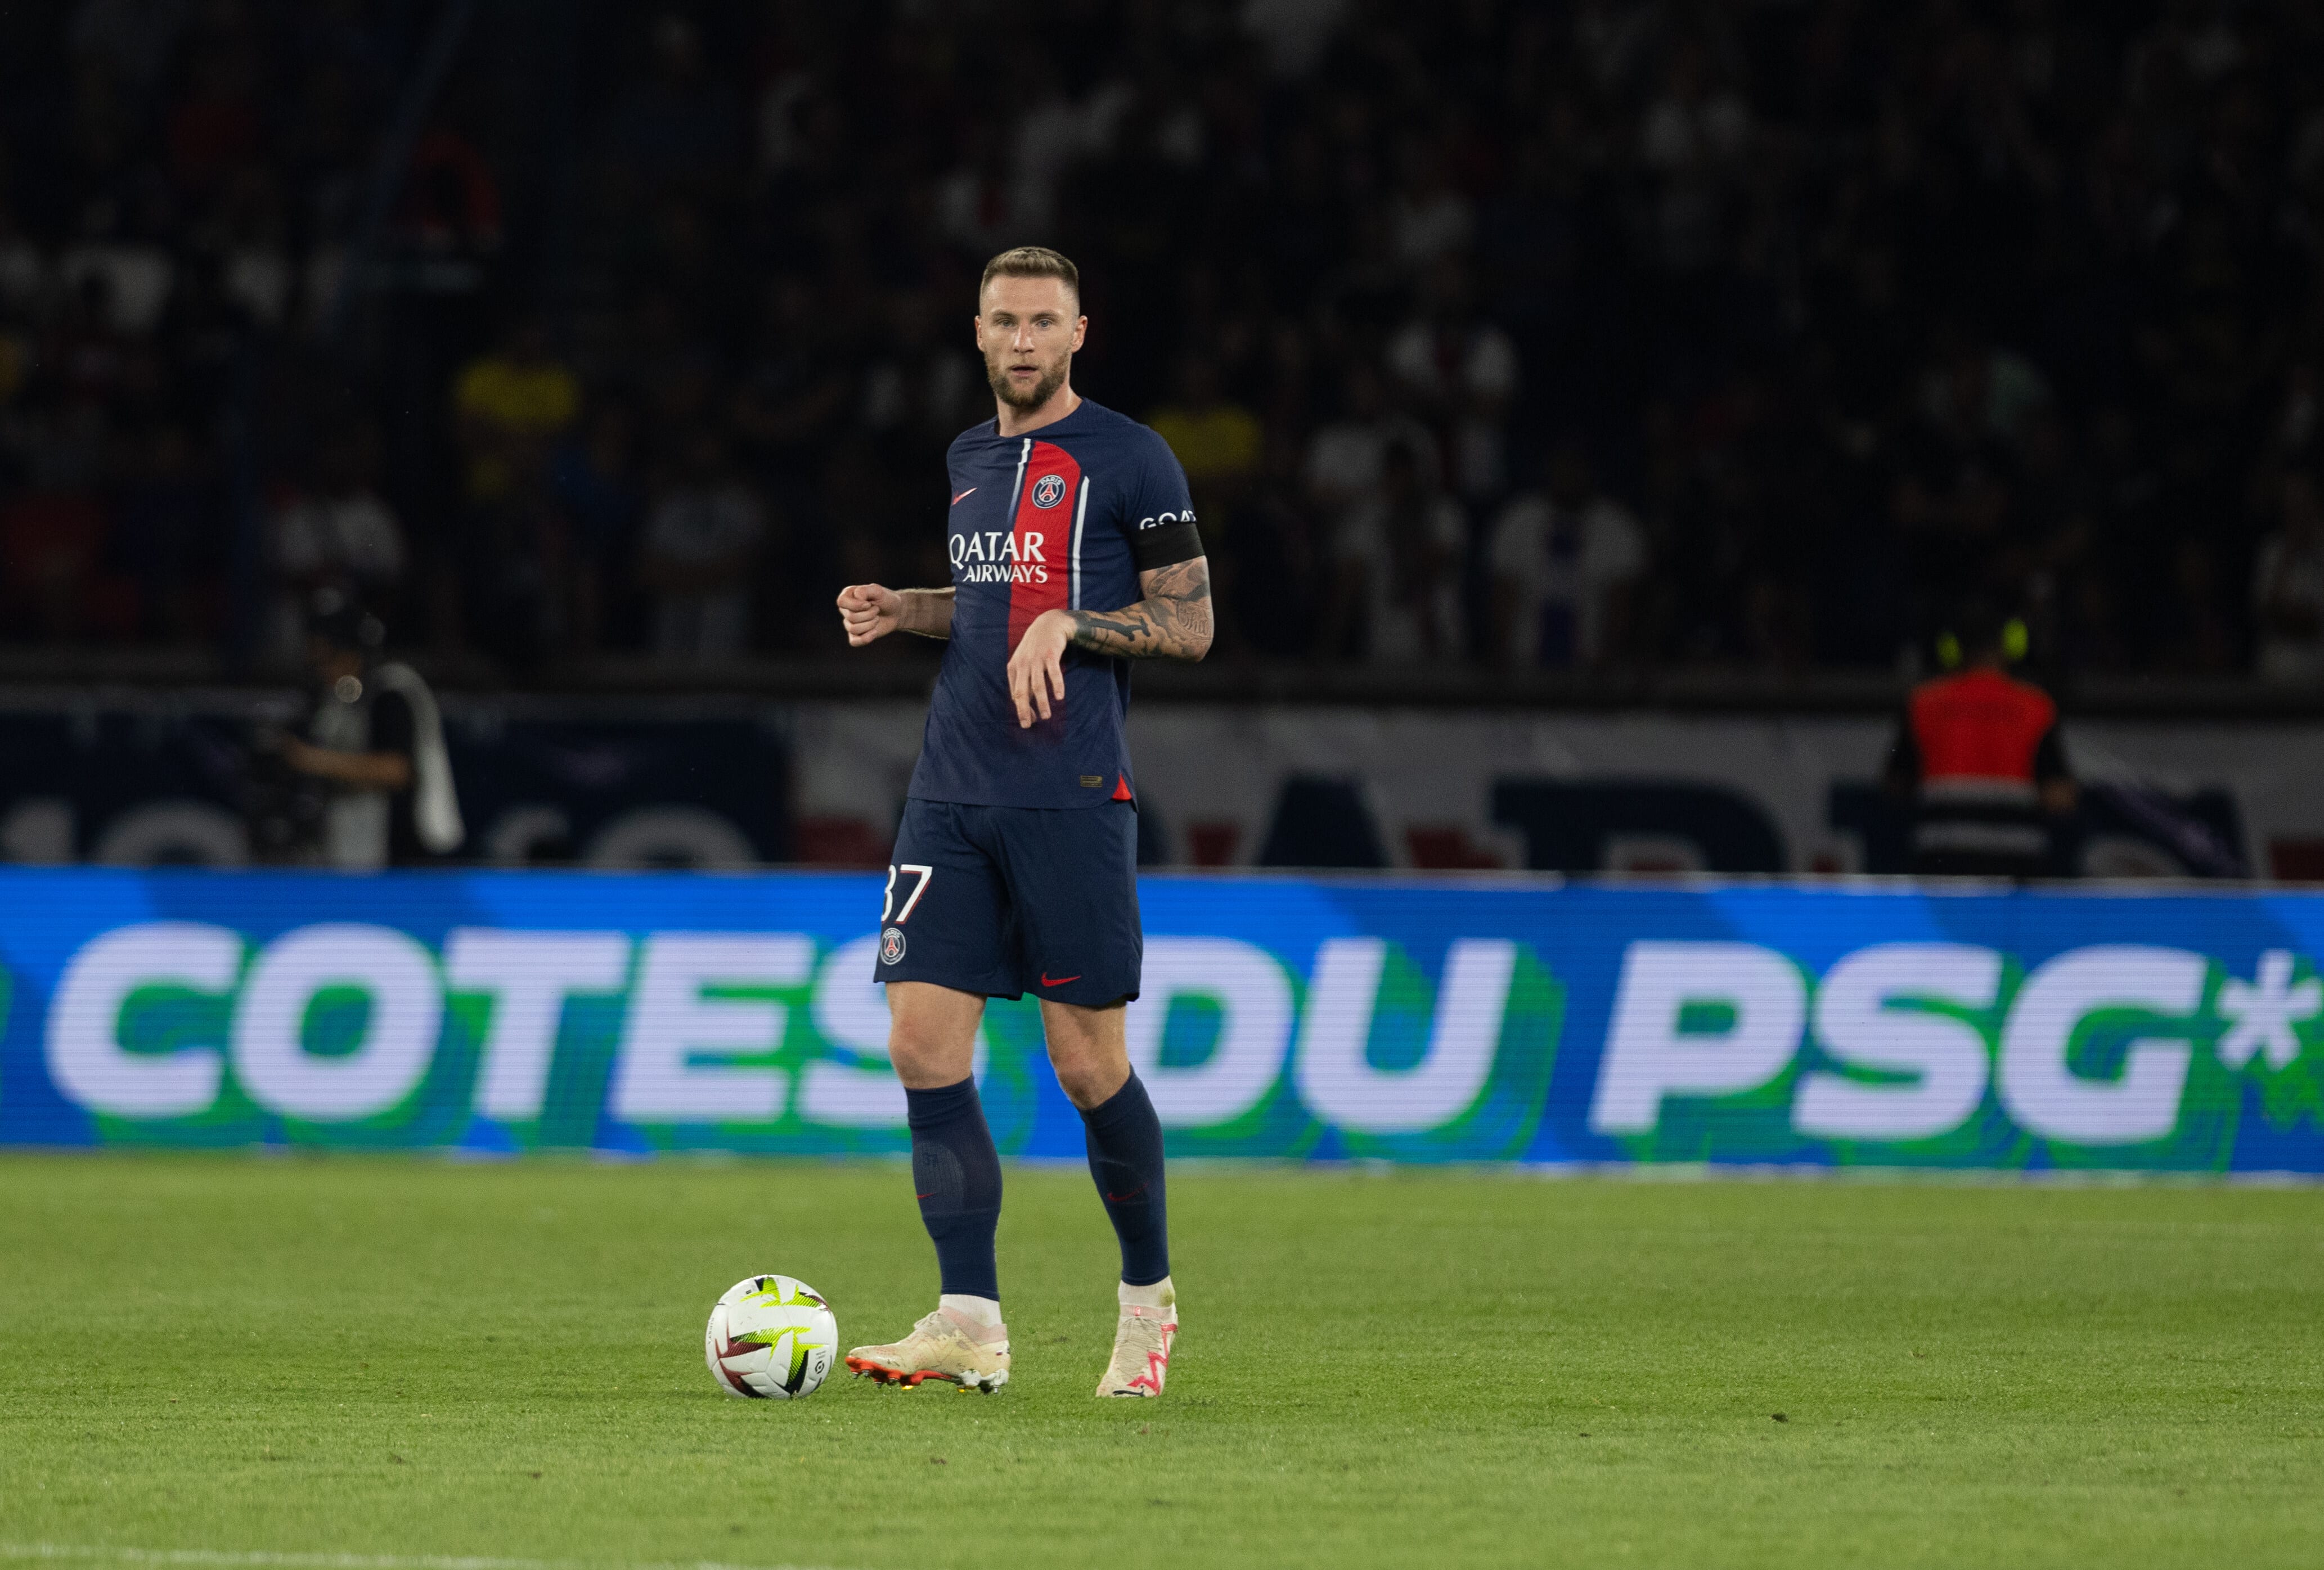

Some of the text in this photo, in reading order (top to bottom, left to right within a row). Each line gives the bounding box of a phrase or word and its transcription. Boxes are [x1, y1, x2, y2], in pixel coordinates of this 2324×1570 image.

[1040, 476, 1062, 485] PARIS
[950, 532, 1046, 570] QATAR
[963, 564, 1048, 583] AIRWAYS
[884, 929, 901, 939] PARIS
[1125, 935, 1519, 1135] DU
